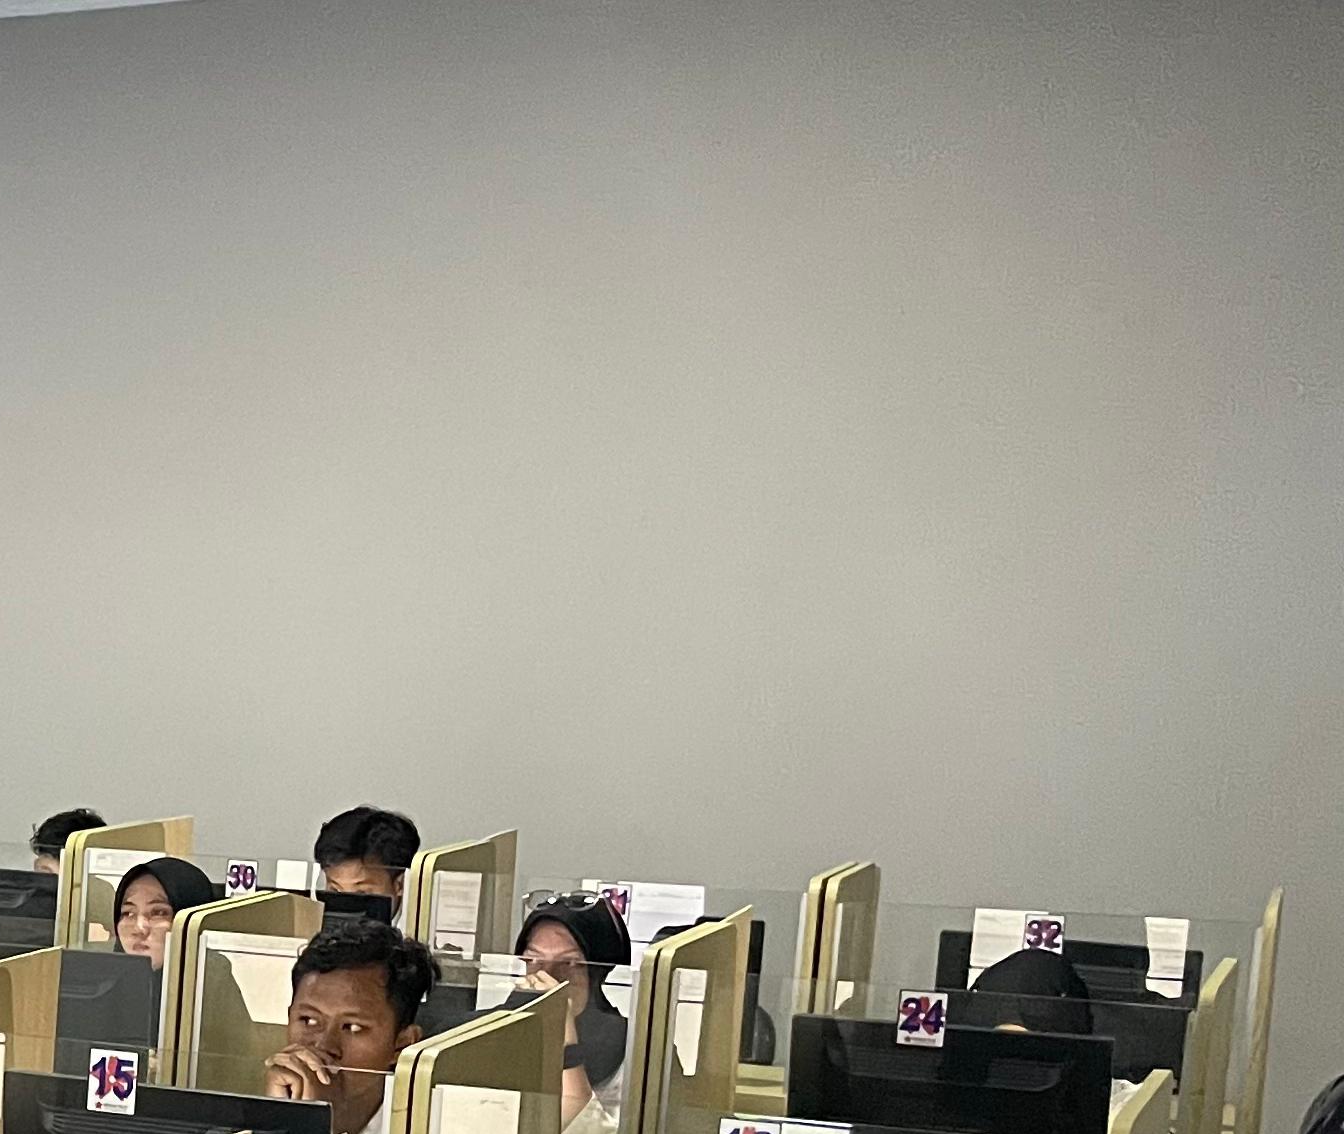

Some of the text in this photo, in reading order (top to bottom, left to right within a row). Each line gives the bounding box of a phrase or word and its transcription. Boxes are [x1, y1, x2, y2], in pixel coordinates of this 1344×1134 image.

[228, 864, 254, 890] 30
[1027, 920, 1061, 948] 32
[900, 998, 944, 1033] 24
[92, 1057, 134, 1100] 15
